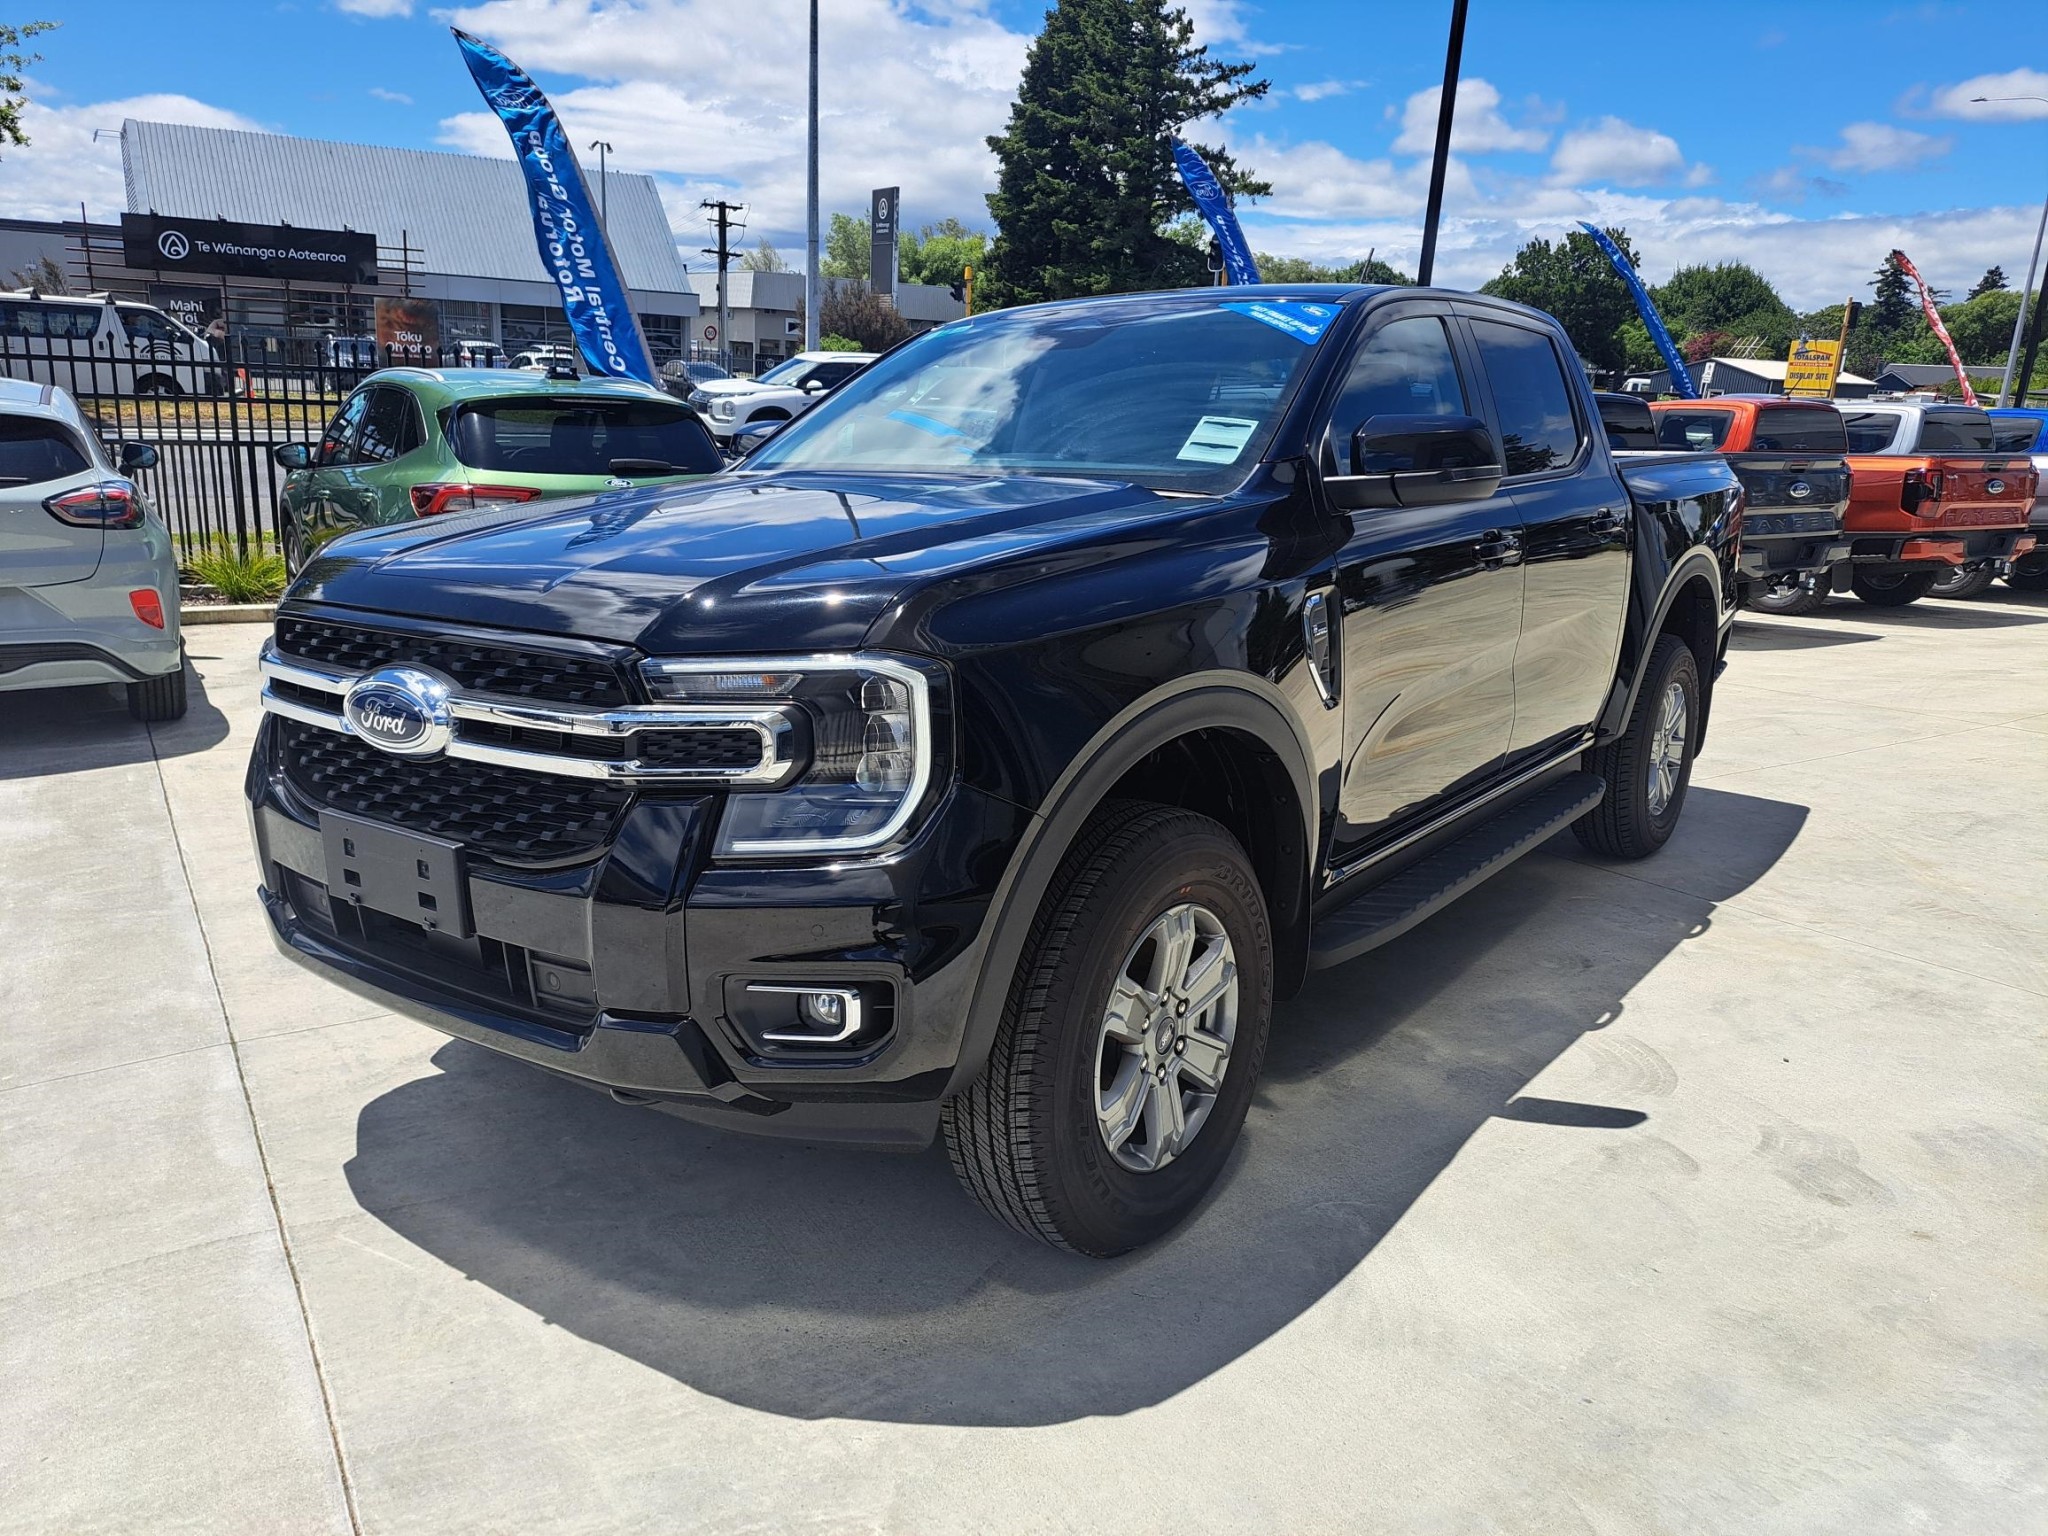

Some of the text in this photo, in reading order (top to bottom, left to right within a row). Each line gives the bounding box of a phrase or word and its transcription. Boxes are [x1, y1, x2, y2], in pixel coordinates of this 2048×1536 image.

[195, 240, 347, 263] Te Wānanga o Aotearoa
[170, 299, 205, 313] Mahi
[176, 311, 199, 324] Toi
[394, 331, 423, 342] Tōku
[1815, 373, 1830, 381] SITE
[361, 696, 407, 735] Ford
